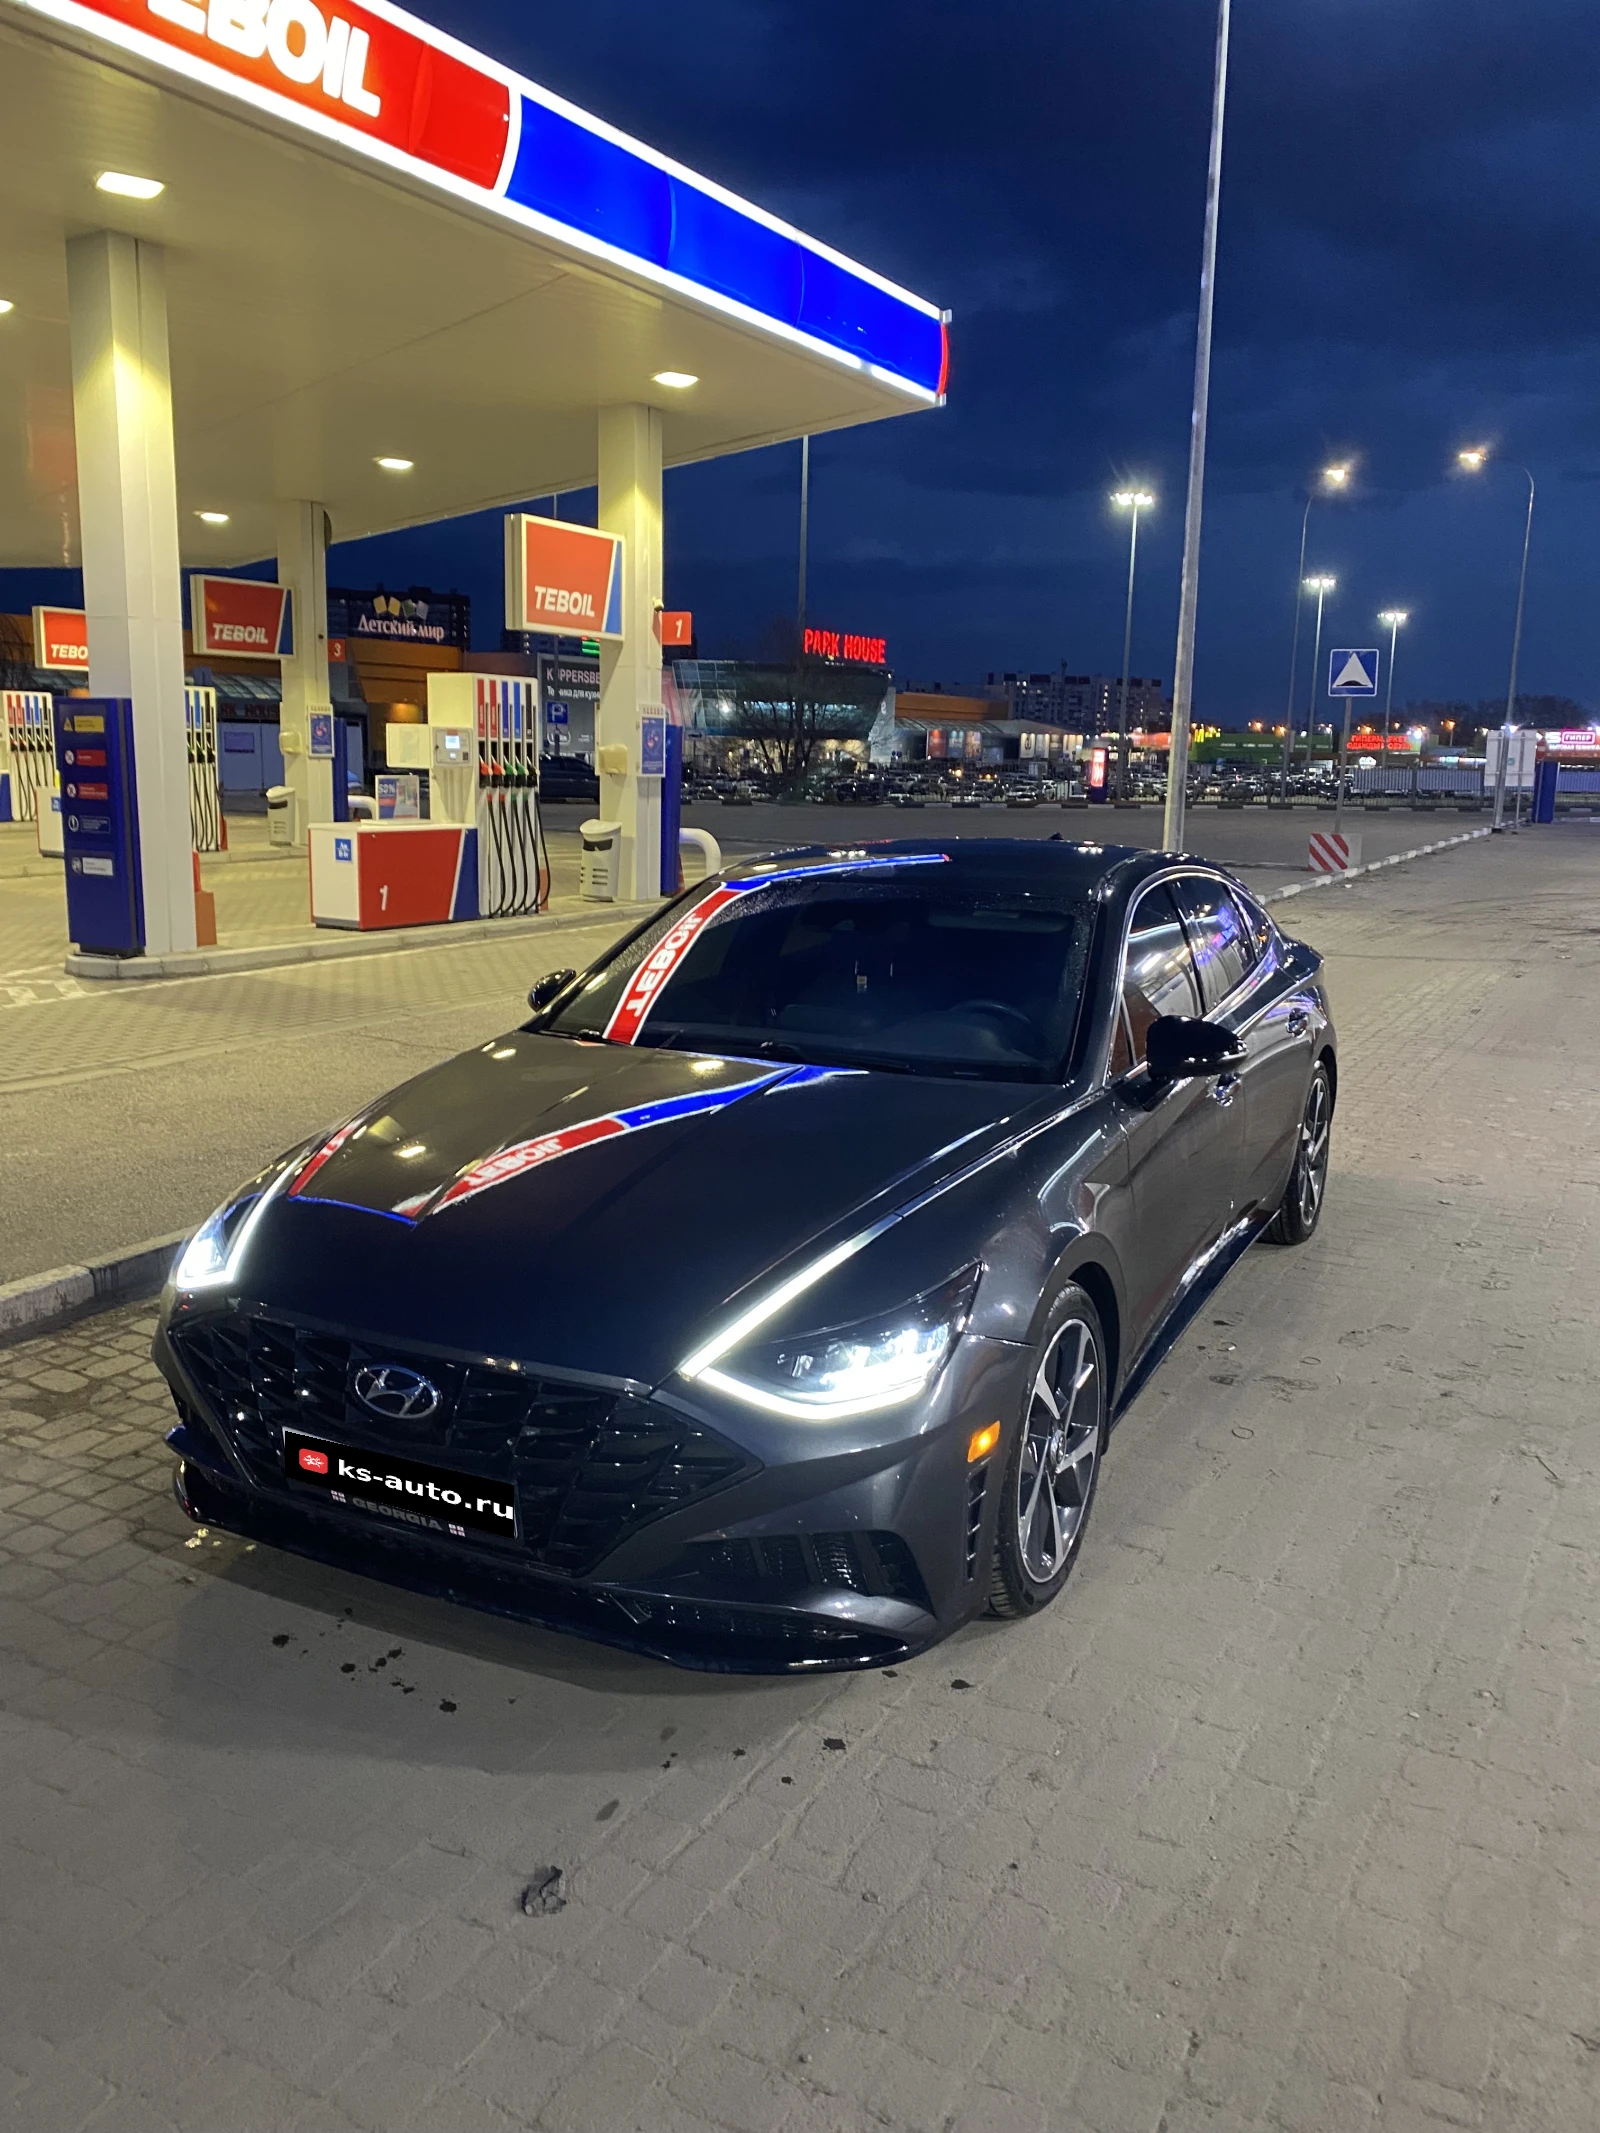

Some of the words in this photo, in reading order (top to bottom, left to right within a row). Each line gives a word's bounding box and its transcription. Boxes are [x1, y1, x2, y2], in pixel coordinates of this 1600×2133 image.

[534, 585, 595, 617] TEBOIL
[212, 622, 269, 644] TEBOIL
[357, 613, 415, 637] Детский
[417, 624, 445, 642] мир
[676, 618, 683, 639] 1
[334, 642, 341, 657] 3
[804, 628, 840, 657] PARK
[843, 634, 886, 664] HOUSE
[552, 703, 564, 722] P
[1351, 734, 1408, 743] ГИПЕРМРКЕТ
[379, 884, 389, 911] 1
[352, 1497, 444, 1531] GEORGIA
